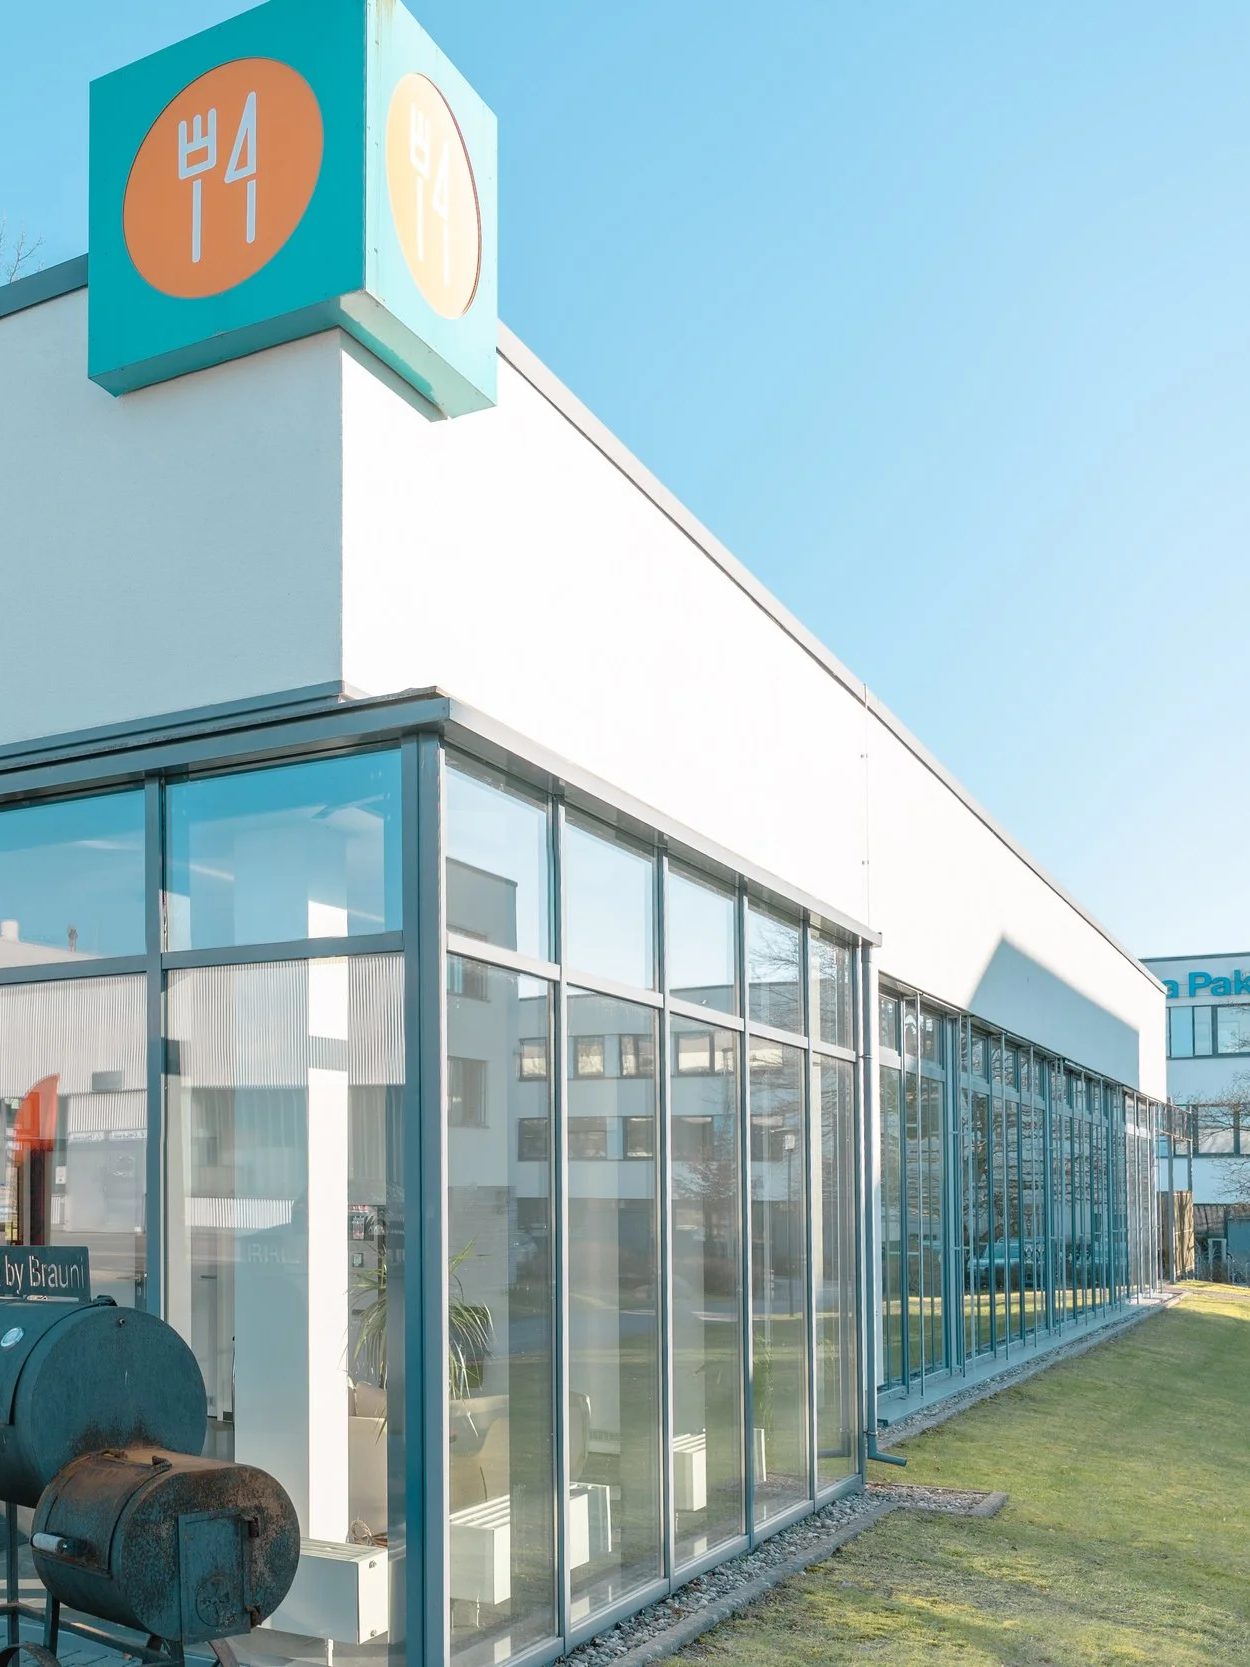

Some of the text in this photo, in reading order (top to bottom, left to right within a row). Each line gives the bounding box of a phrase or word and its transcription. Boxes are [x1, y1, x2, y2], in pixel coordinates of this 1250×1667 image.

[1188, 969, 1250, 998] Pak
[4, 1254, 24, 1295] by
[28, 1254, 85, 1289] Brauni
